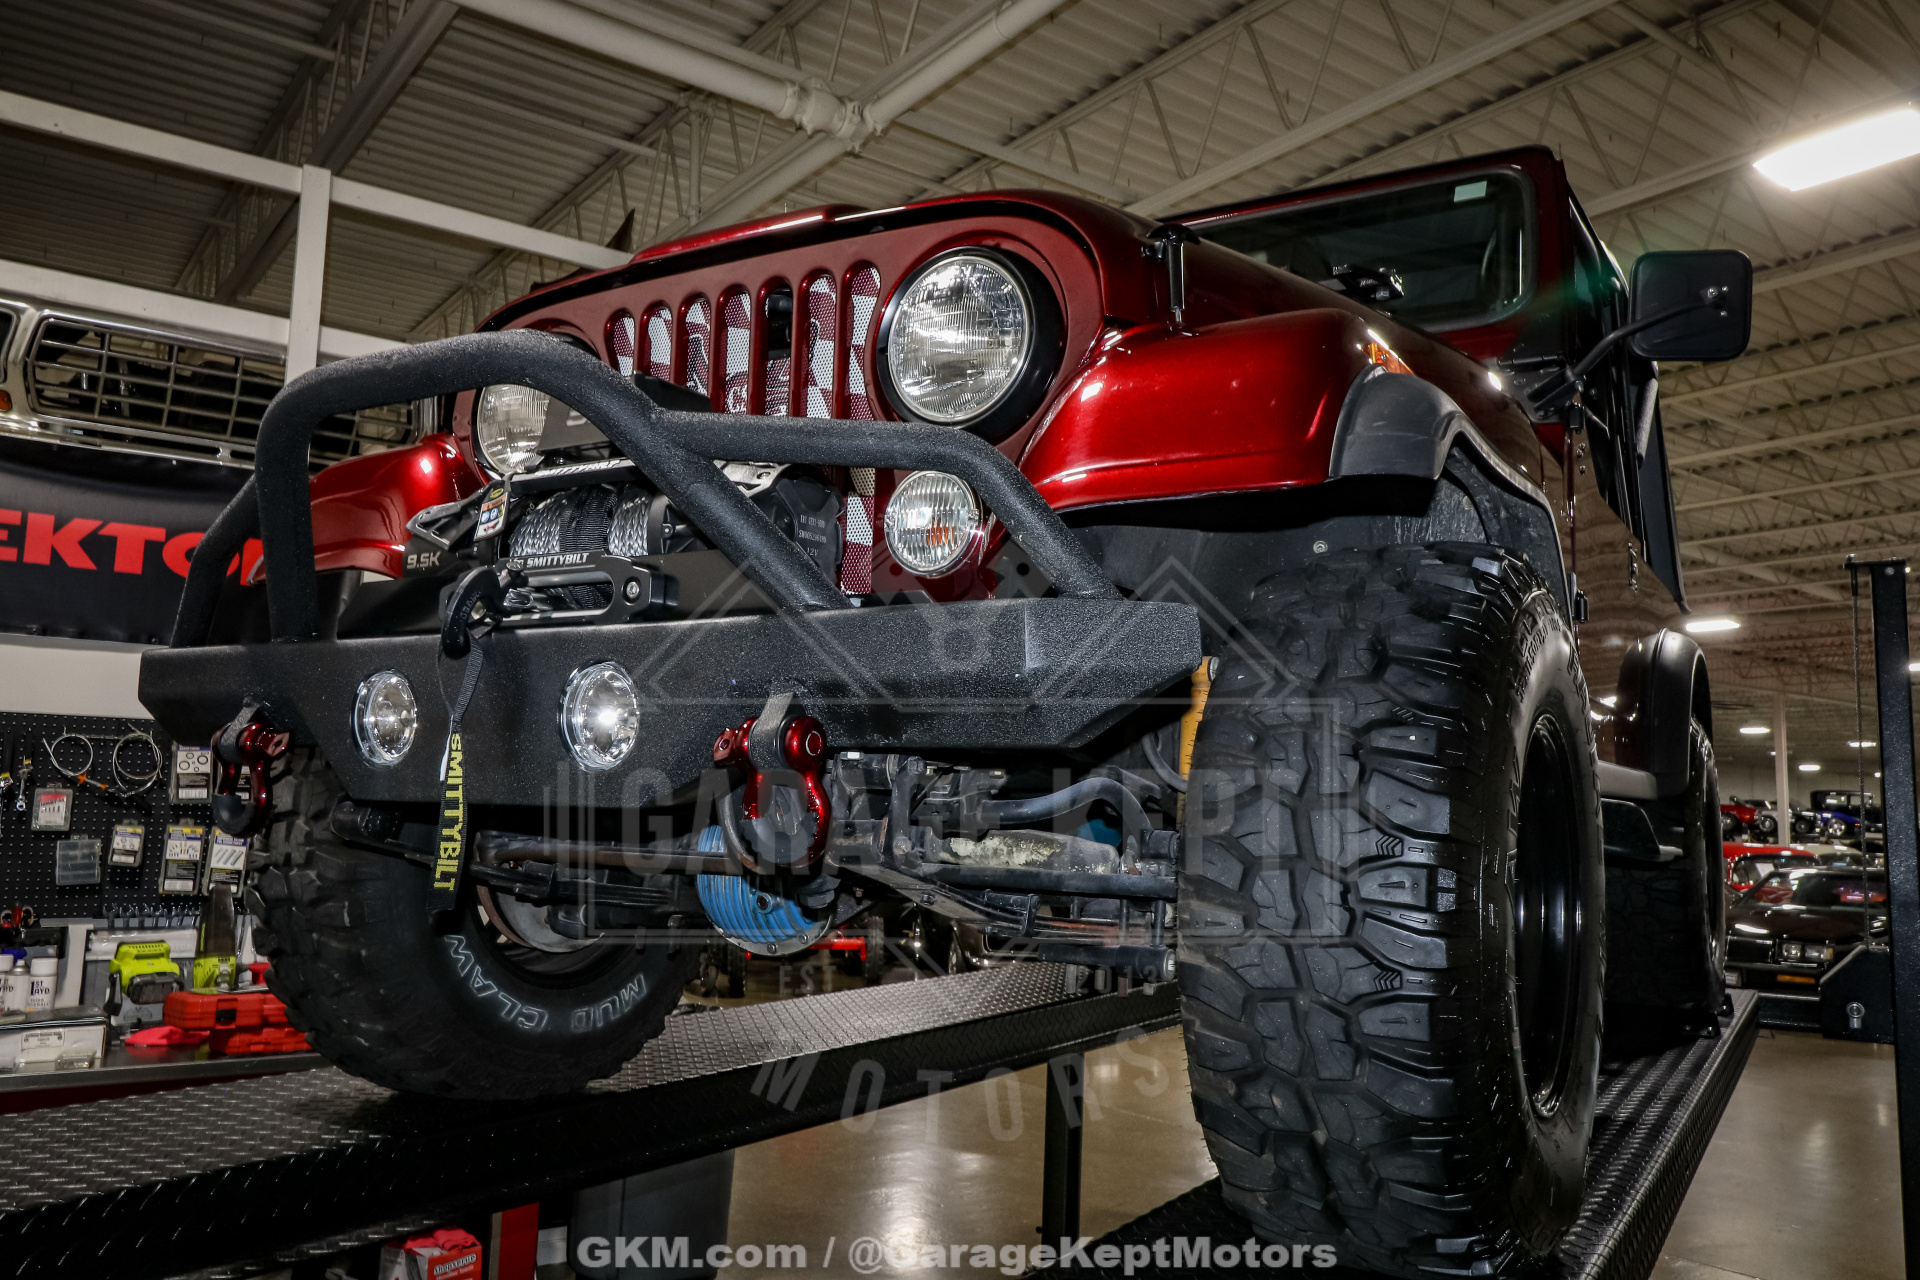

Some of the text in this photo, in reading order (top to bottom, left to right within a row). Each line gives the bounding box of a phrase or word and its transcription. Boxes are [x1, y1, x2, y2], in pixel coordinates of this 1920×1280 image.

[406, 552, 441, 570] 9.5K
[526, 552, 589, 568] SMITTYBILT
[434, 733, 463, 891] SMITTYBILT
[443, 934, 648, 1034] MUD CLAW
